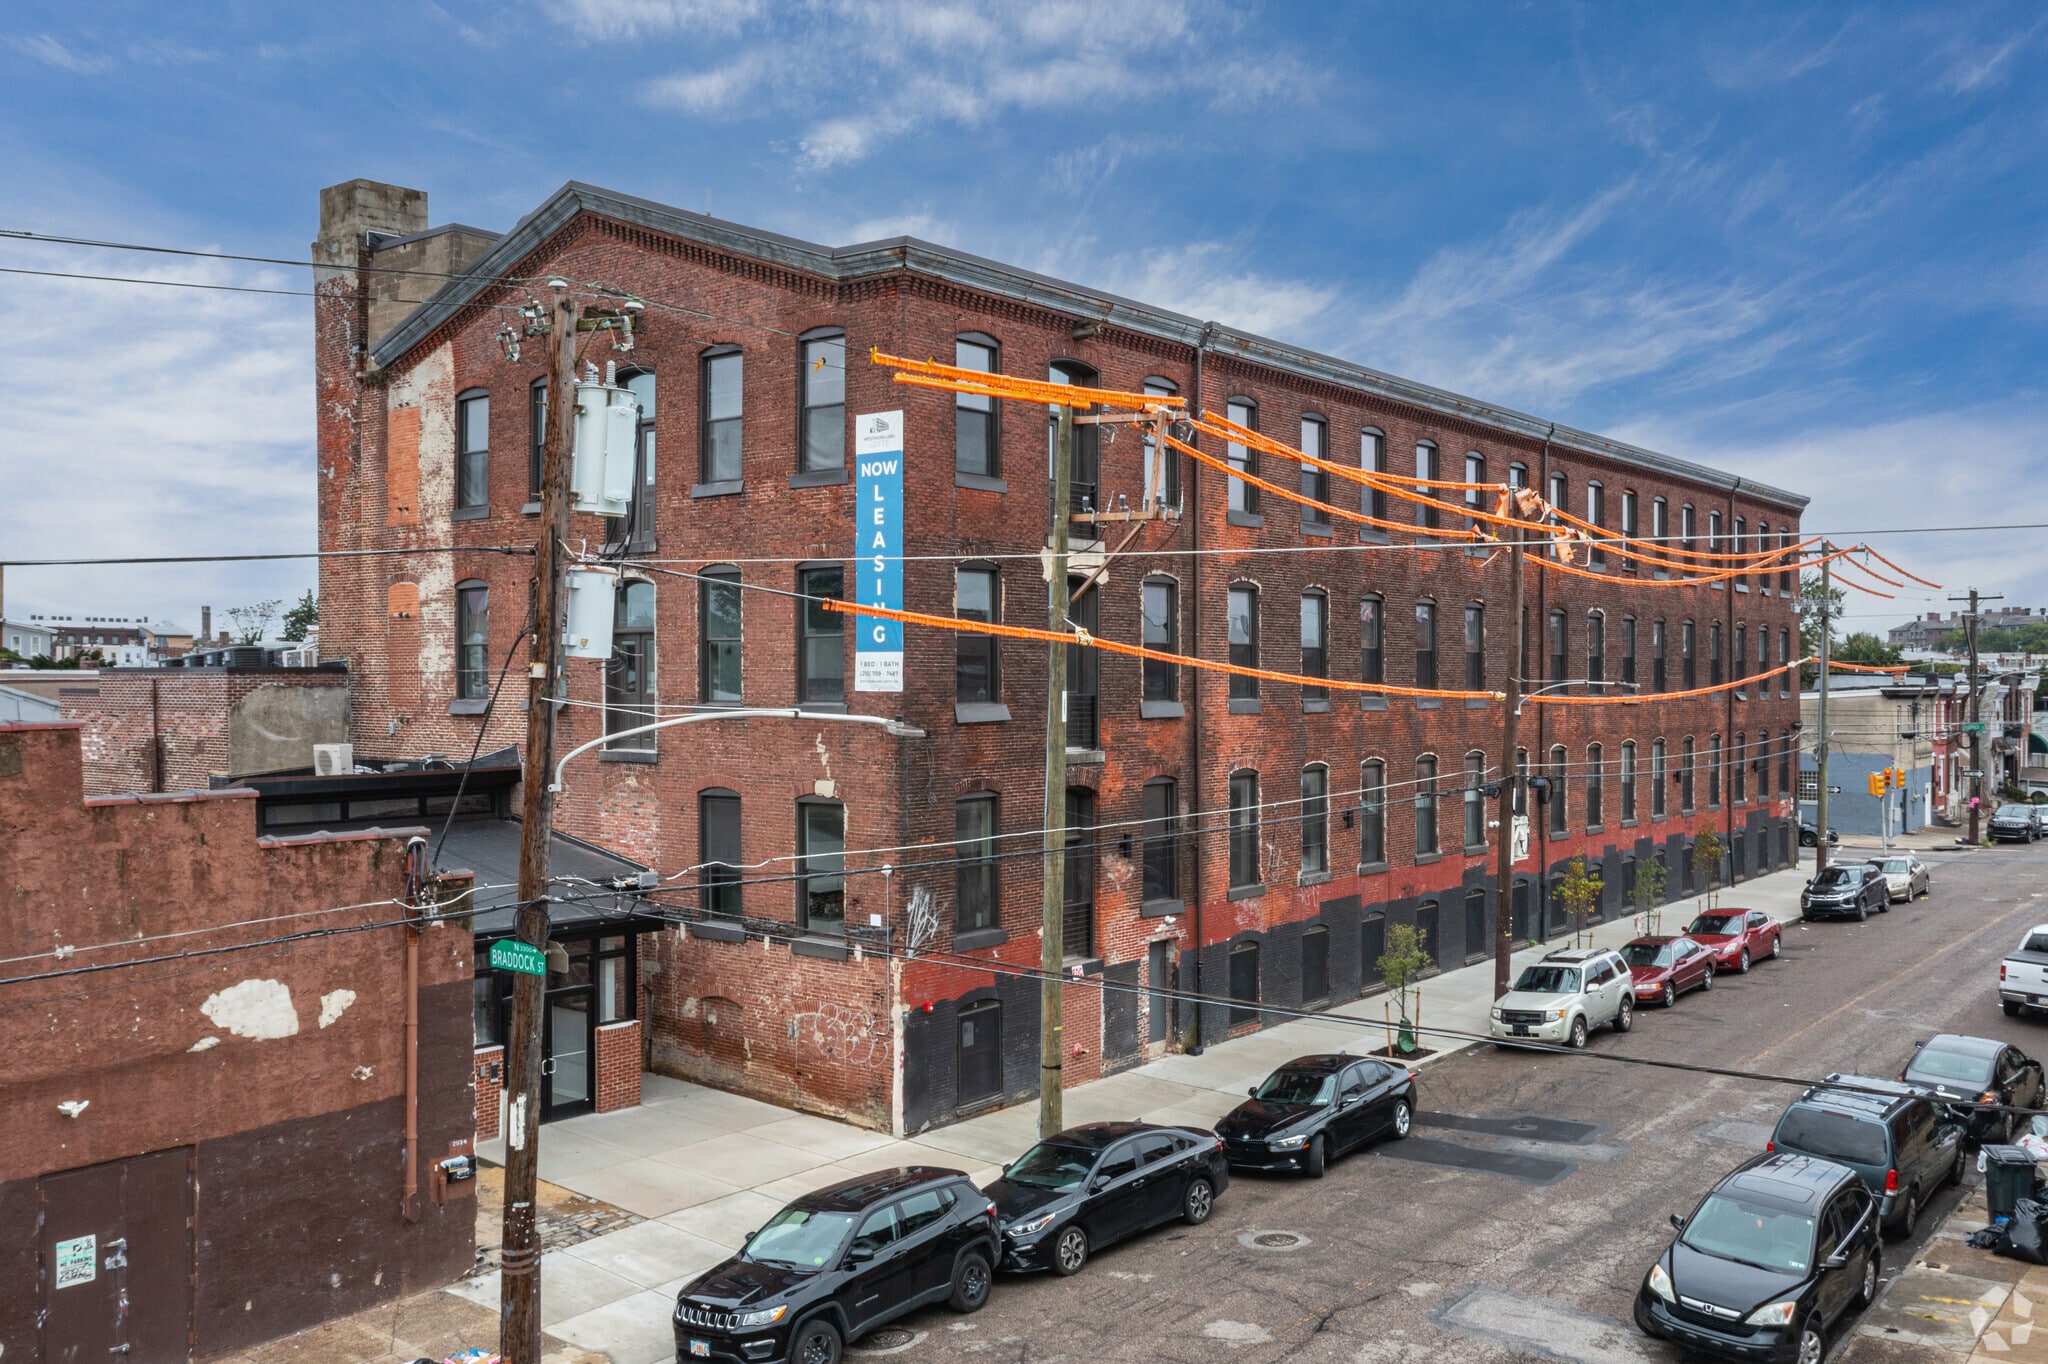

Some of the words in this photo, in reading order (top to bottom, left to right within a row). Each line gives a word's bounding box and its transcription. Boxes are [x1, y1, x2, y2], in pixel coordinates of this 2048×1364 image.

[861, 460, 898, 477] NOW
[514, 943, 519, 951] N
[492, 949, 535, 971] BRADDOCK
[537, 961, 544, 973] ST
[70, 1255, 93, 1264] PARKING
